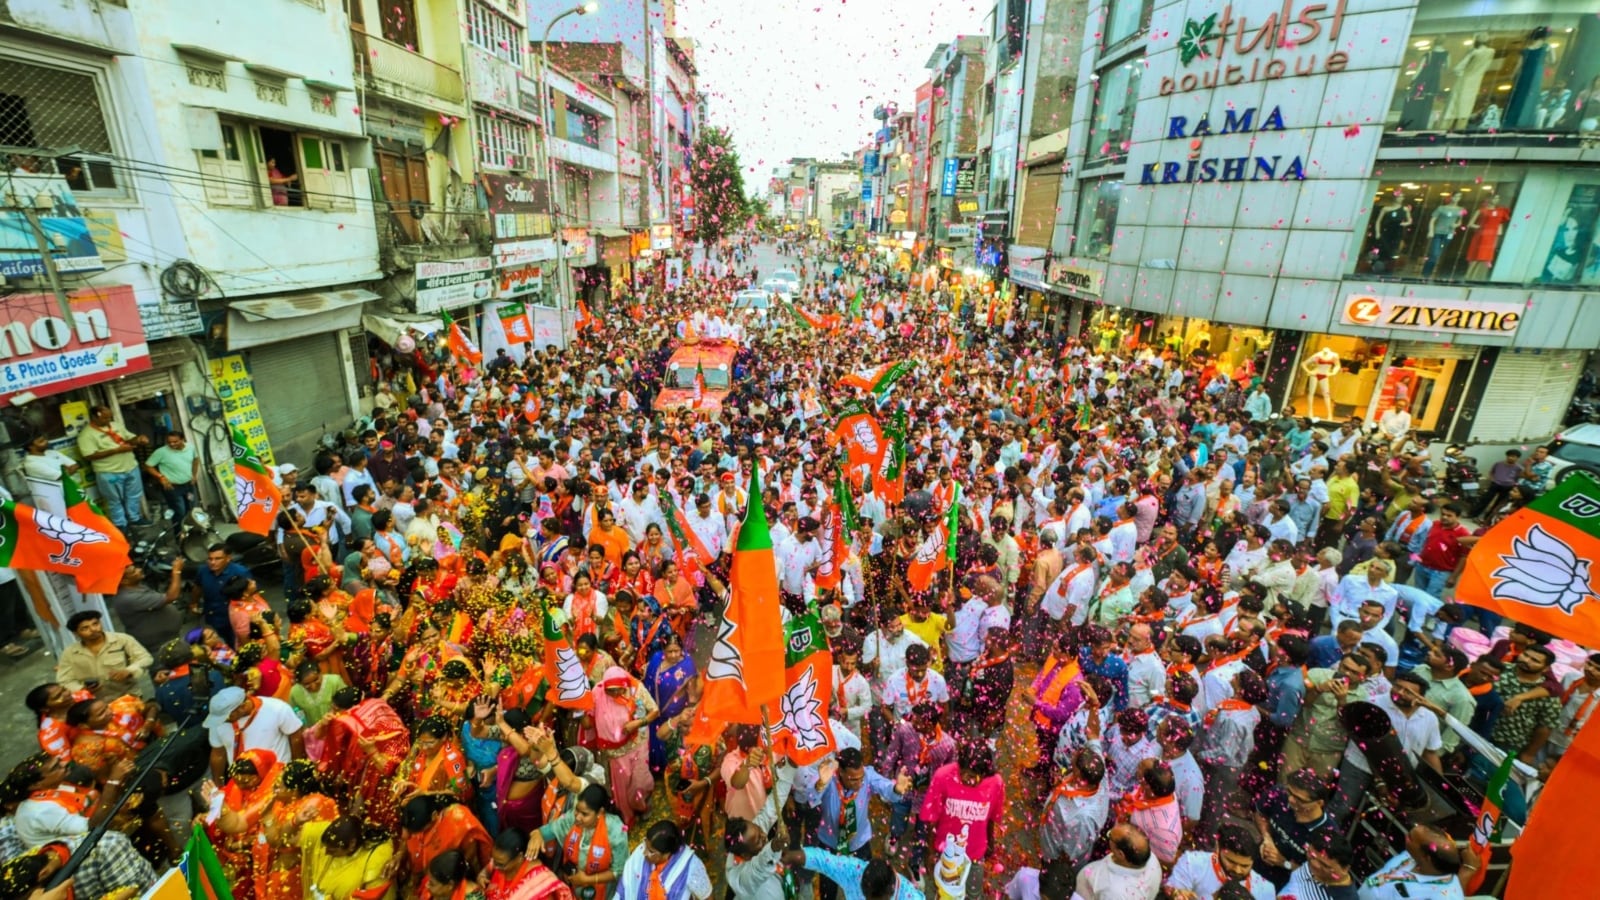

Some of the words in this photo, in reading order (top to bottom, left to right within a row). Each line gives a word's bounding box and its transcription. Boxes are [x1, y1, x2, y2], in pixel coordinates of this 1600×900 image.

[1159, 51, 1349, 96] boutique
[1167, 105, 1286, 140] RAMA
[1140, 155, 1306, 185] KRISHNA
[5, 366, 17, 382] &
[18, 359, 57, 380] Photo
[59, 351, 98, 370] Goods
